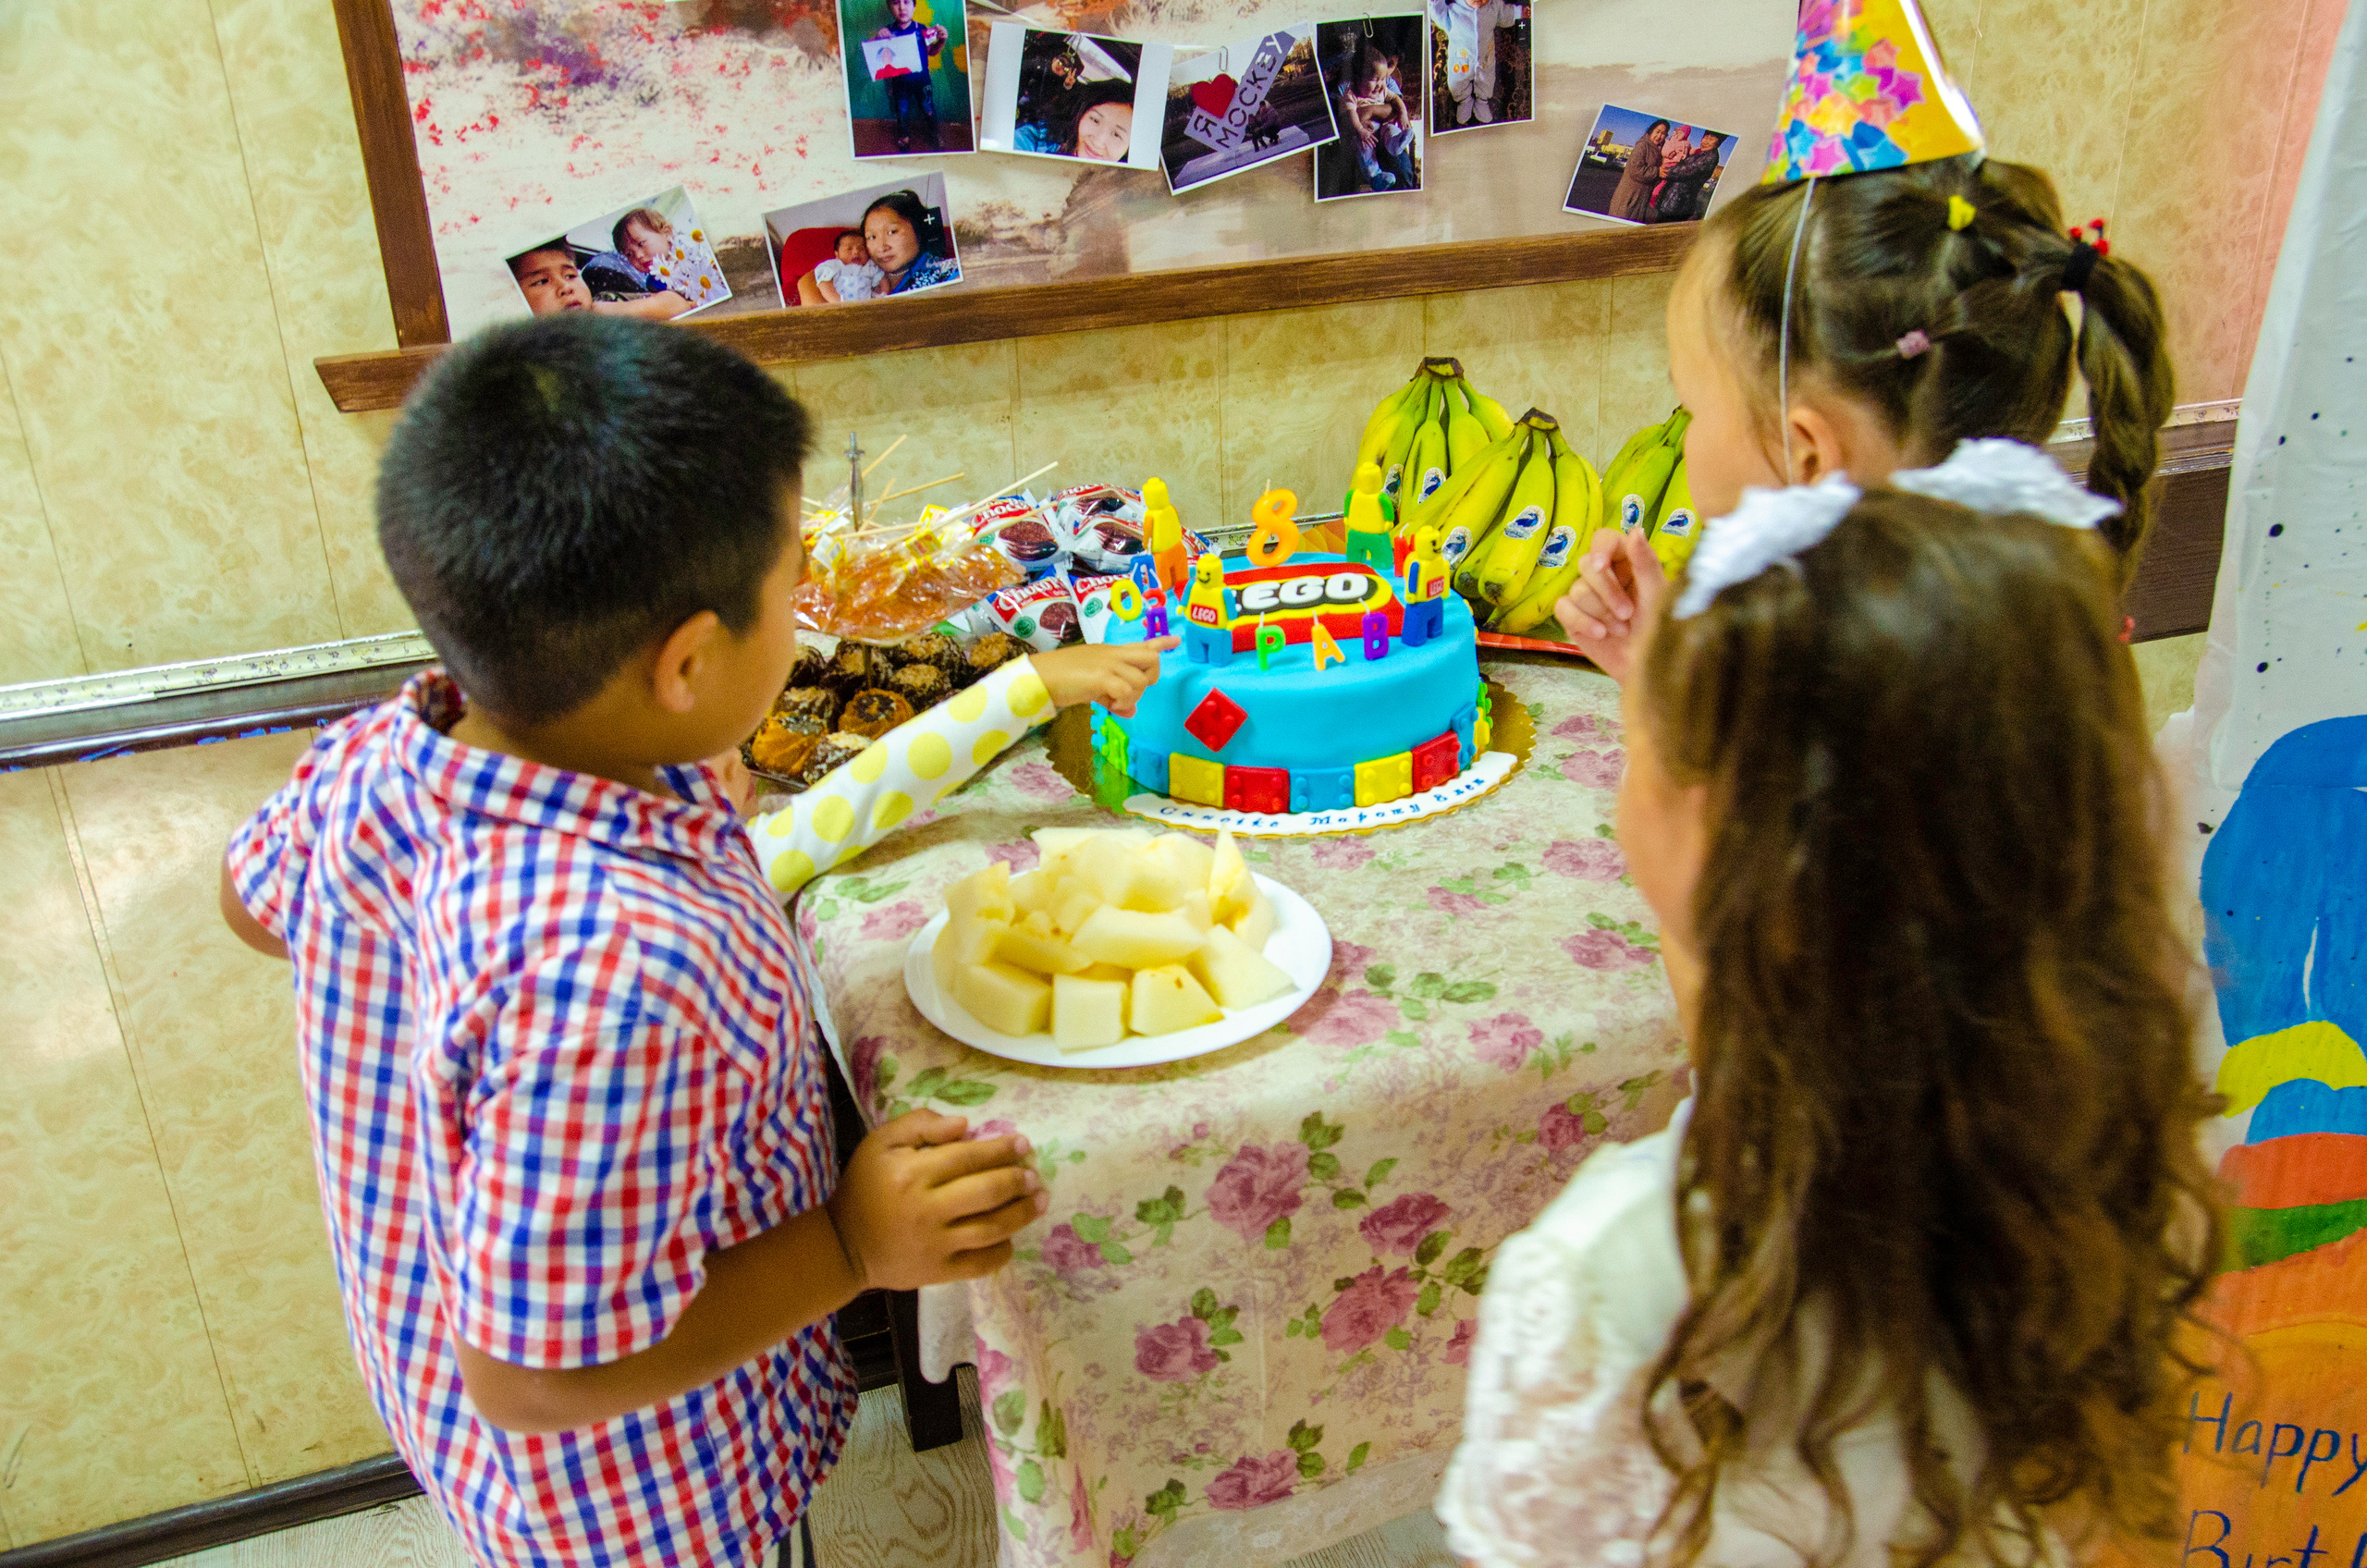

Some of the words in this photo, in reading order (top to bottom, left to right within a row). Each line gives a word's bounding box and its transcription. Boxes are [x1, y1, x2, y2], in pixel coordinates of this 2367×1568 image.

[1245, 488, 1300, 568] 8
[1192, 606, 1217, 623] LEGO
[1232, 572, 1368, 612] EGO
[2183, 1390, 2367, 1498] Happy
